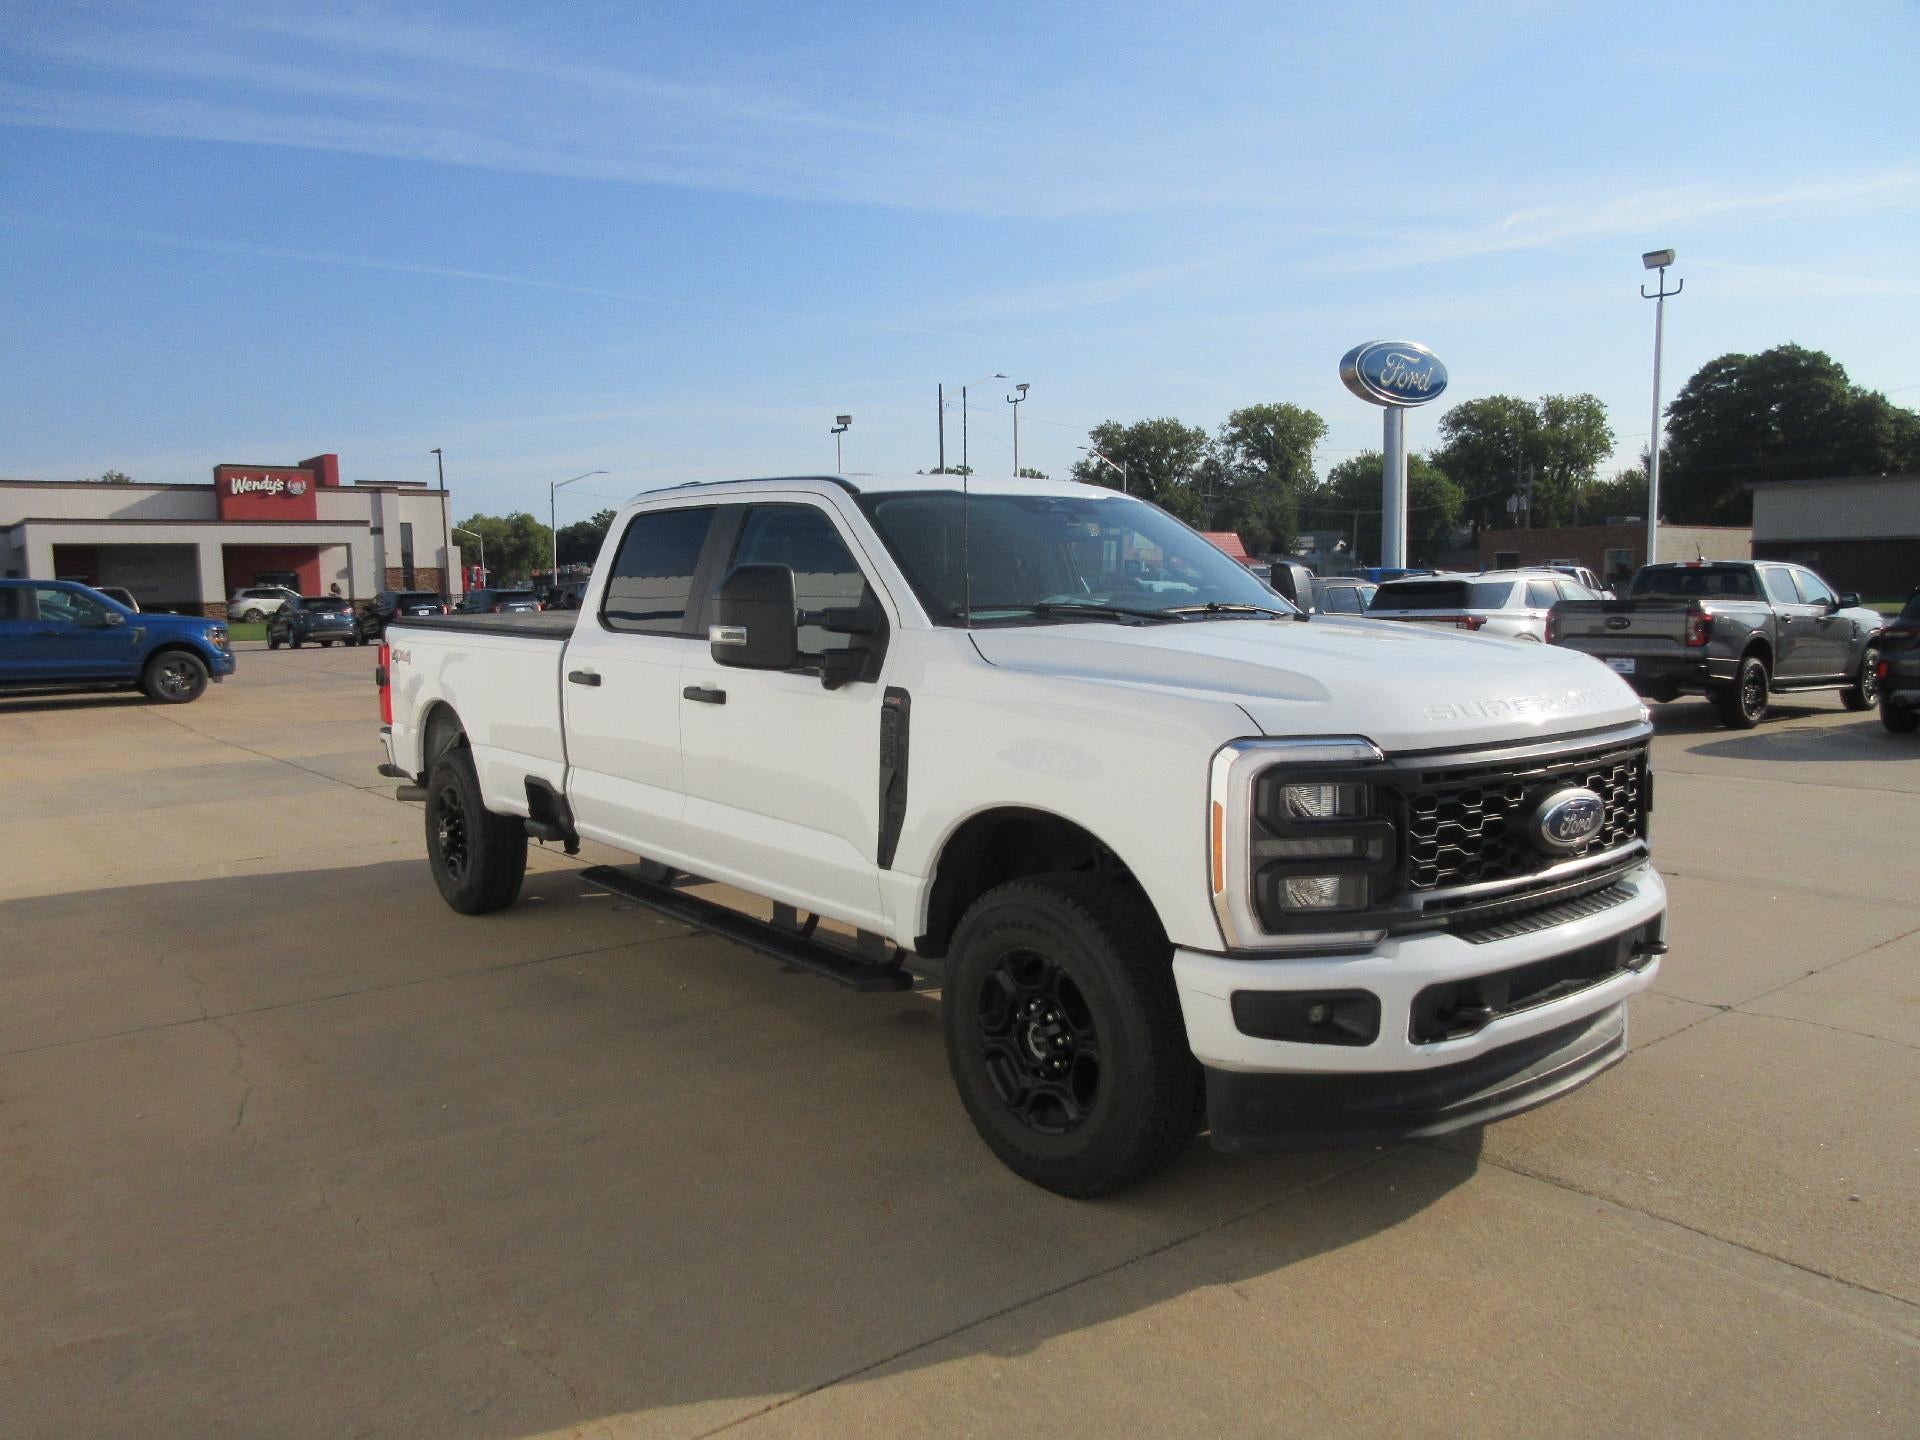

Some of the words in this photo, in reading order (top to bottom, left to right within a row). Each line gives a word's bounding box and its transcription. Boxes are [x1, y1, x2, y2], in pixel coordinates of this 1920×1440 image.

[1380, 352, 1432, 392] Ford
[231, 474, 284, 495] Wendy's
[1560, 807, 1594, 837] Ford
